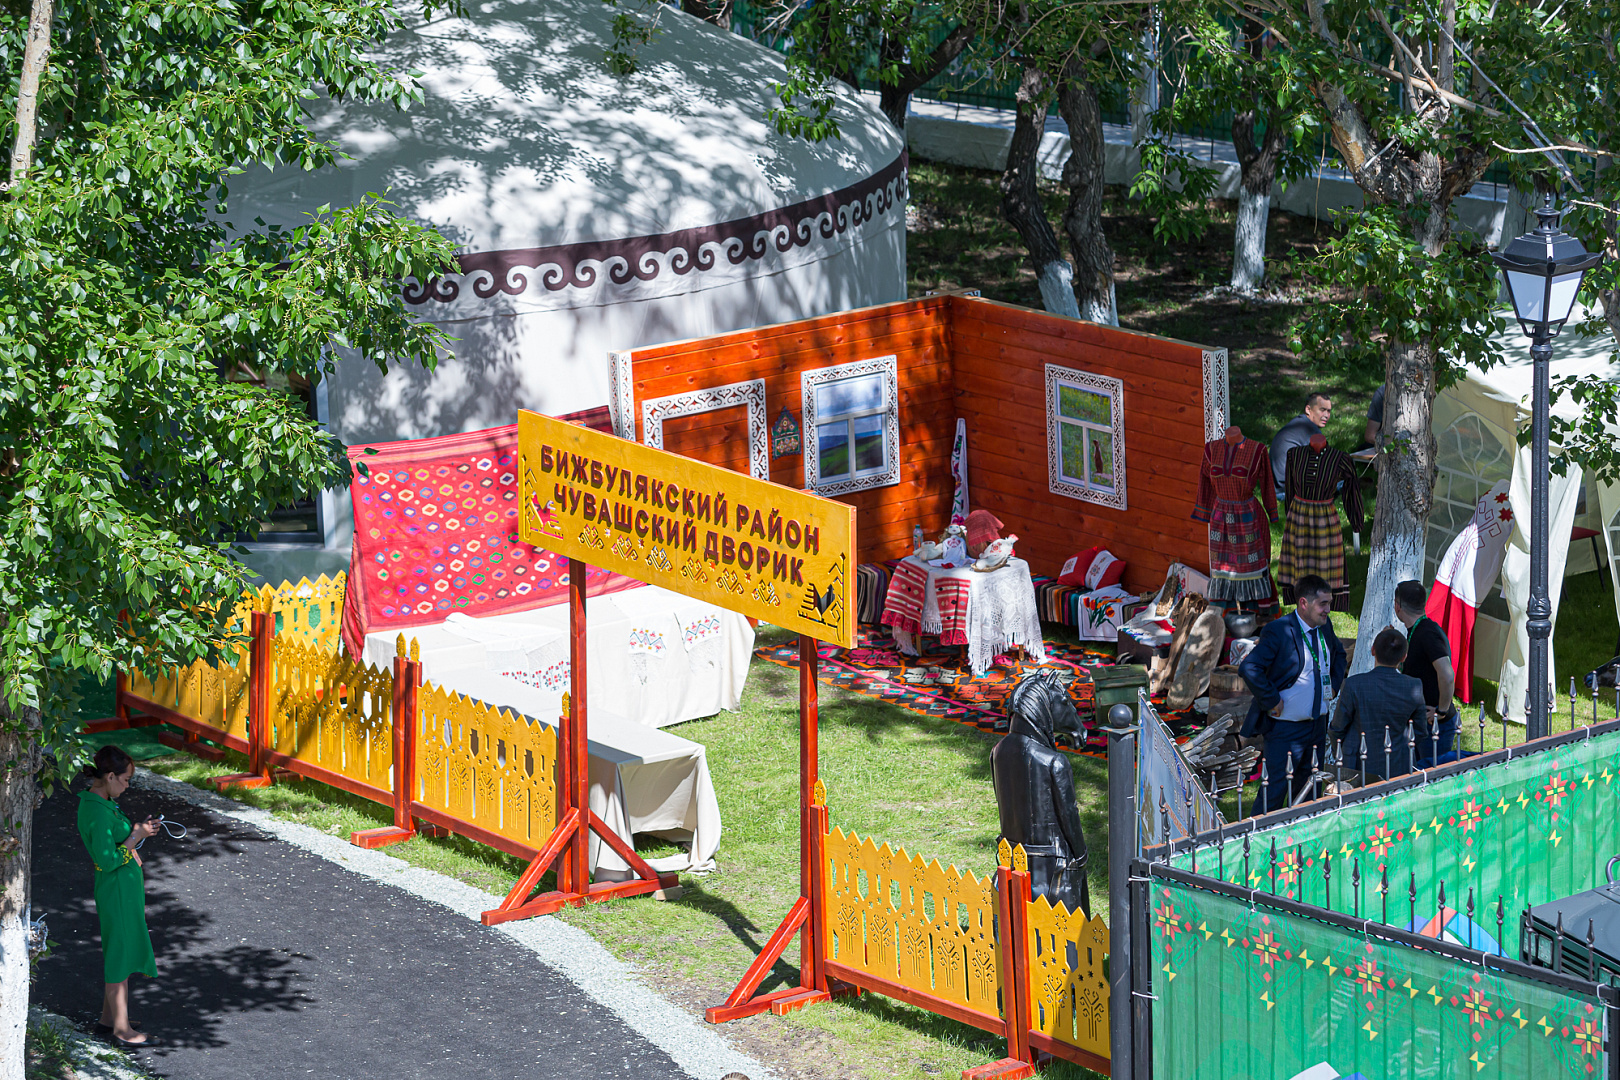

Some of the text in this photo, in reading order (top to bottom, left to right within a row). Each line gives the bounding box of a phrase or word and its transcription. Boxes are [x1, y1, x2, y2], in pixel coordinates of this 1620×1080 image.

[541, 444, 819, 555] БИЖБУЛЯКСКИЙ РАЙОН
[554, 483, 804, 586] ЧУВАШСКИЙ ДВОРИК
